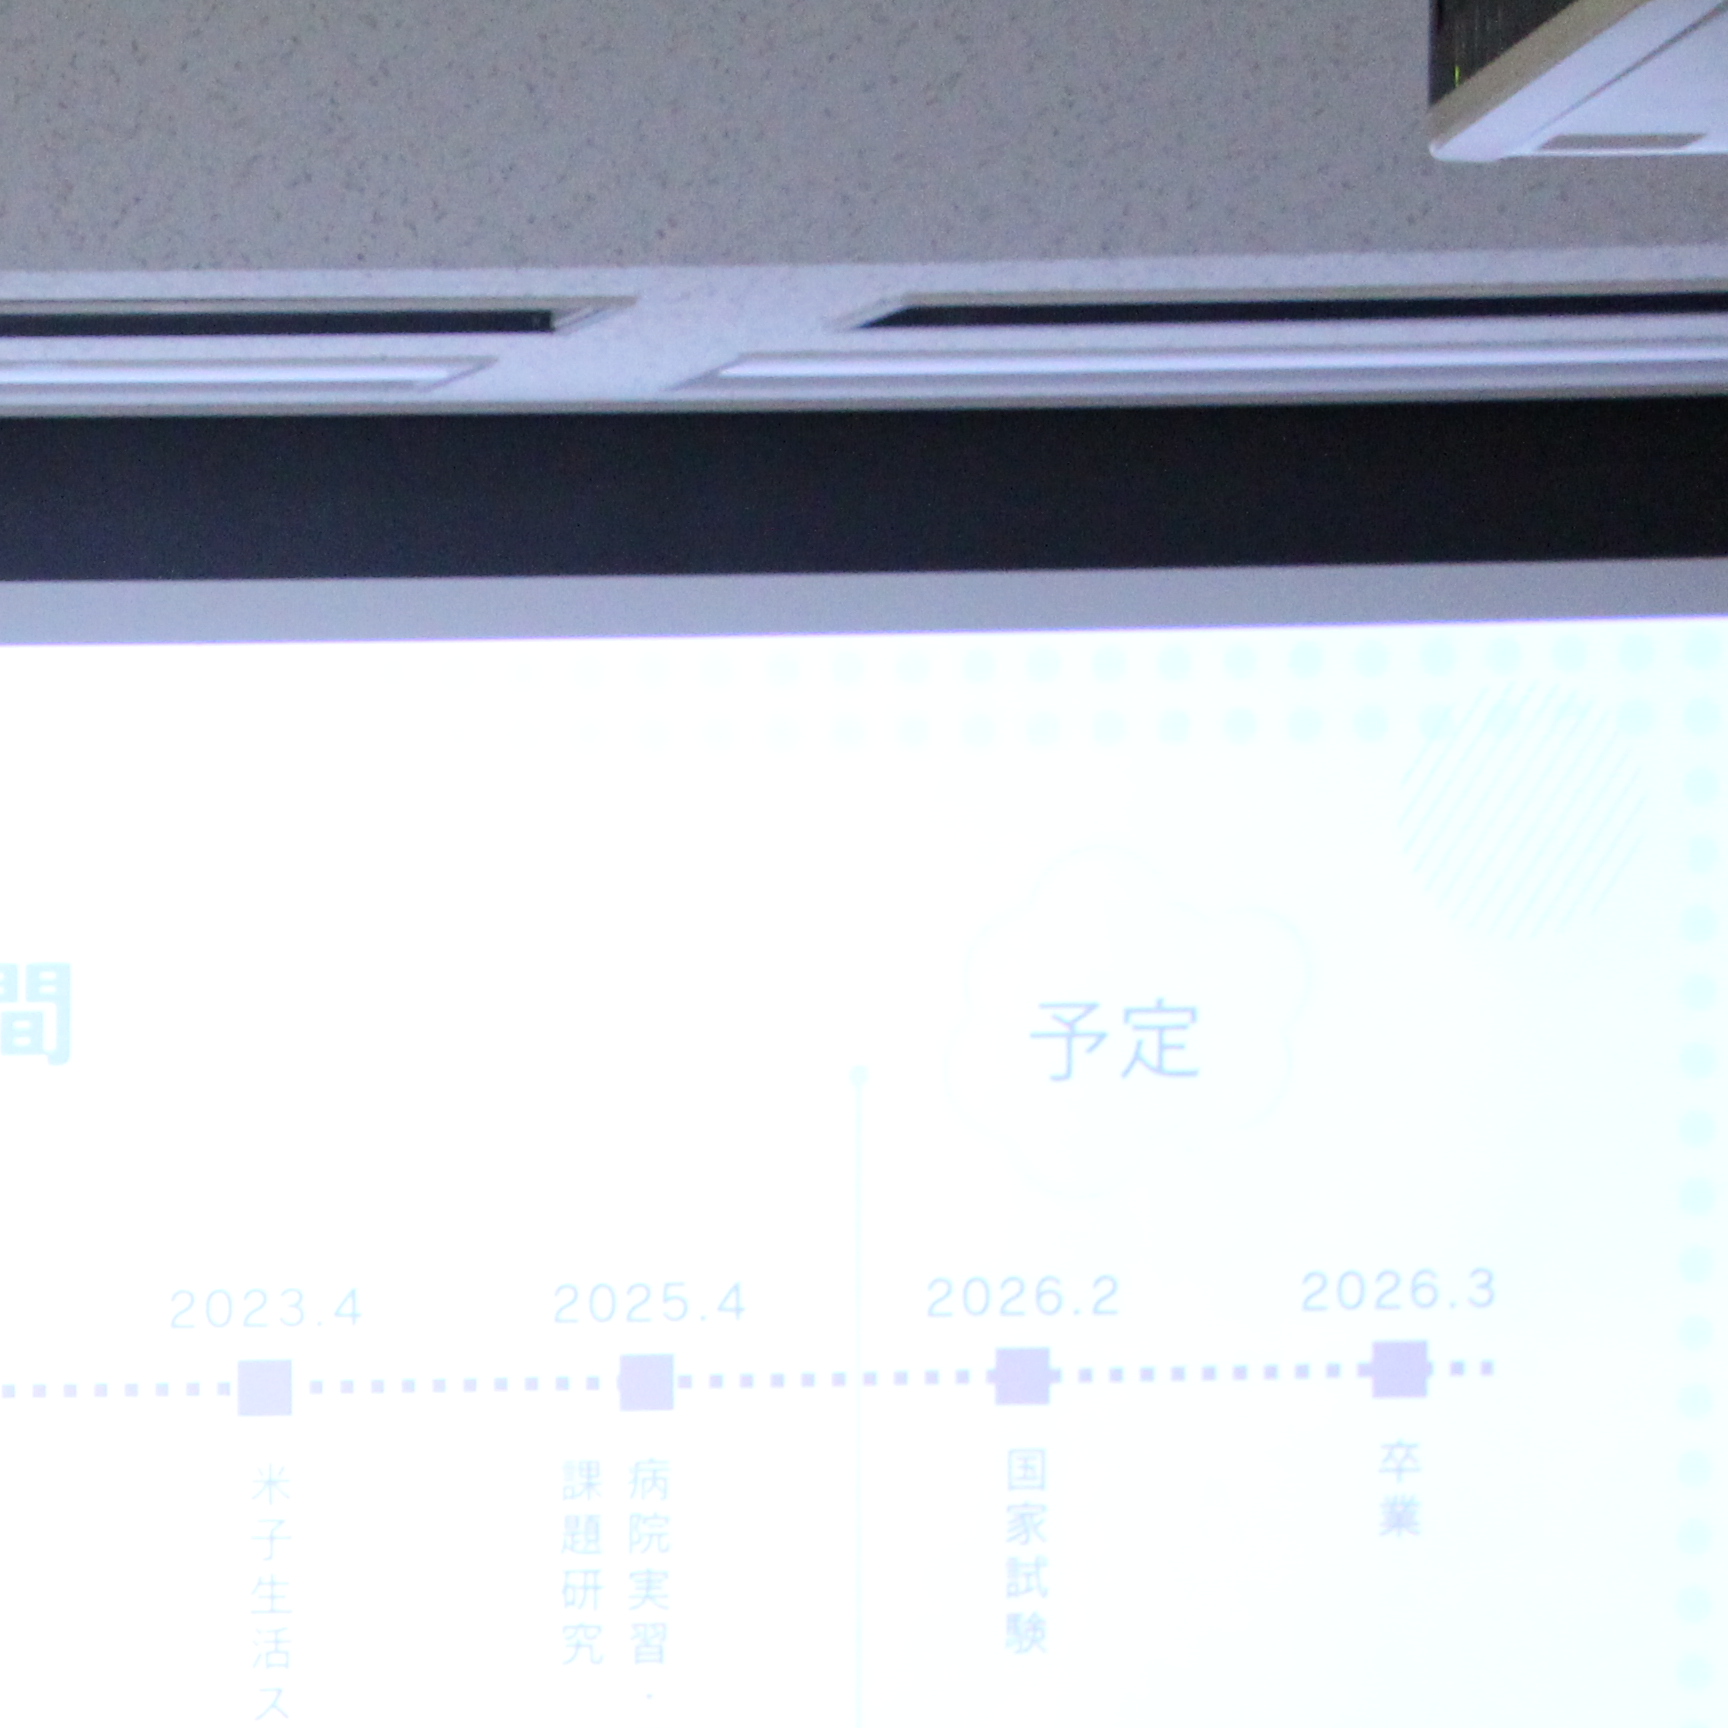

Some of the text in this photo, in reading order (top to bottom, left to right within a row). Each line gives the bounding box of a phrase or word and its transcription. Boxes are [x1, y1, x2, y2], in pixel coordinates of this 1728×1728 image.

[1029, 997, 1199, 1081] 予定
[169, 1287, 364, 1330] 2023.4
[553, 1280, 748, 1325] 2025.4
[927, 1273, 1121, 1318] 2026.2
[1302, 1265, 1498, 1312] 2026.3
[1379, 1437, 1423, 1538] 卒業
[560, 1458, 606, 1666] 課題研究
[1004, 1446, 1050, 1655] 国家試験
